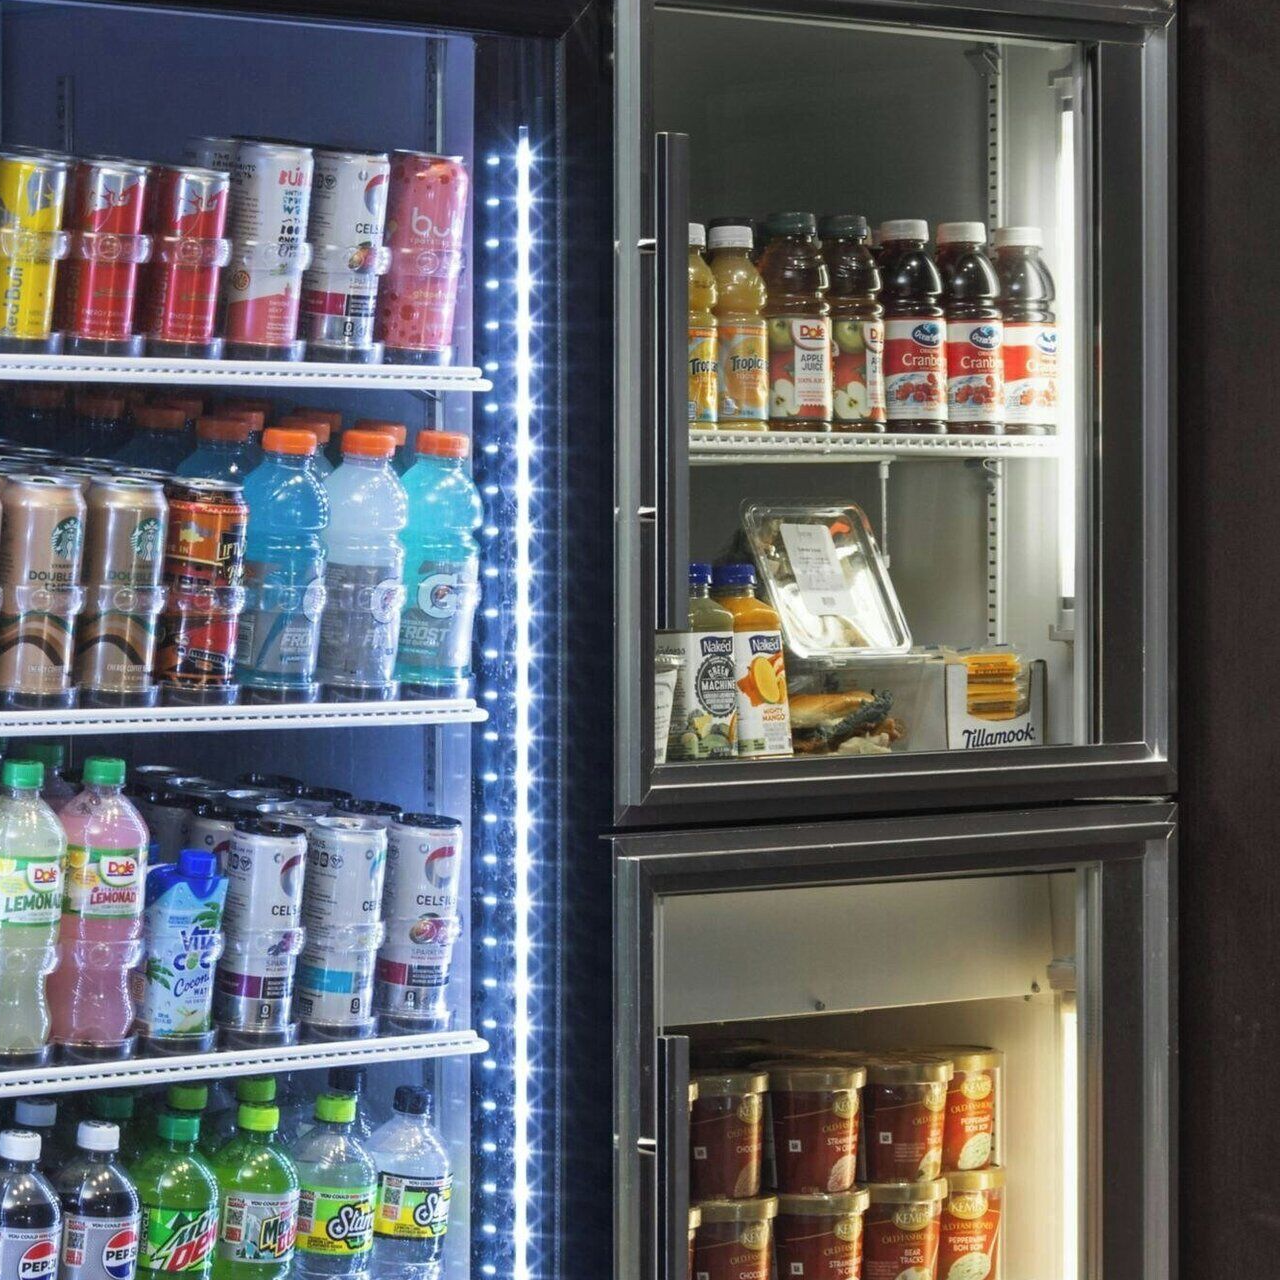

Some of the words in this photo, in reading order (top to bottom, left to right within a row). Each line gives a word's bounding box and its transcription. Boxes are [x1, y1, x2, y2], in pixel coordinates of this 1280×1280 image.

[800, 324, 825, 339] Dole
[800, 354, 825, 363] APPLE
[801, 361, 825, 371] JUICE
[398, 627, 453, 642] FROST
[703, 640, 732, 653] Naked
[752, 640, 781, 652] Naked
[762, 713, 786, 721] MANGO
[962, 722, 1035, 750] Tillamook
[107, 861, 136, 875] Dole
[34, 867, 58, 883] Dole
[141, 1204, 150, 1254] RECYCLE
[900, 1254, 924, 1263] TRACKS
[903, 1248, 921, 1256] BEAR
